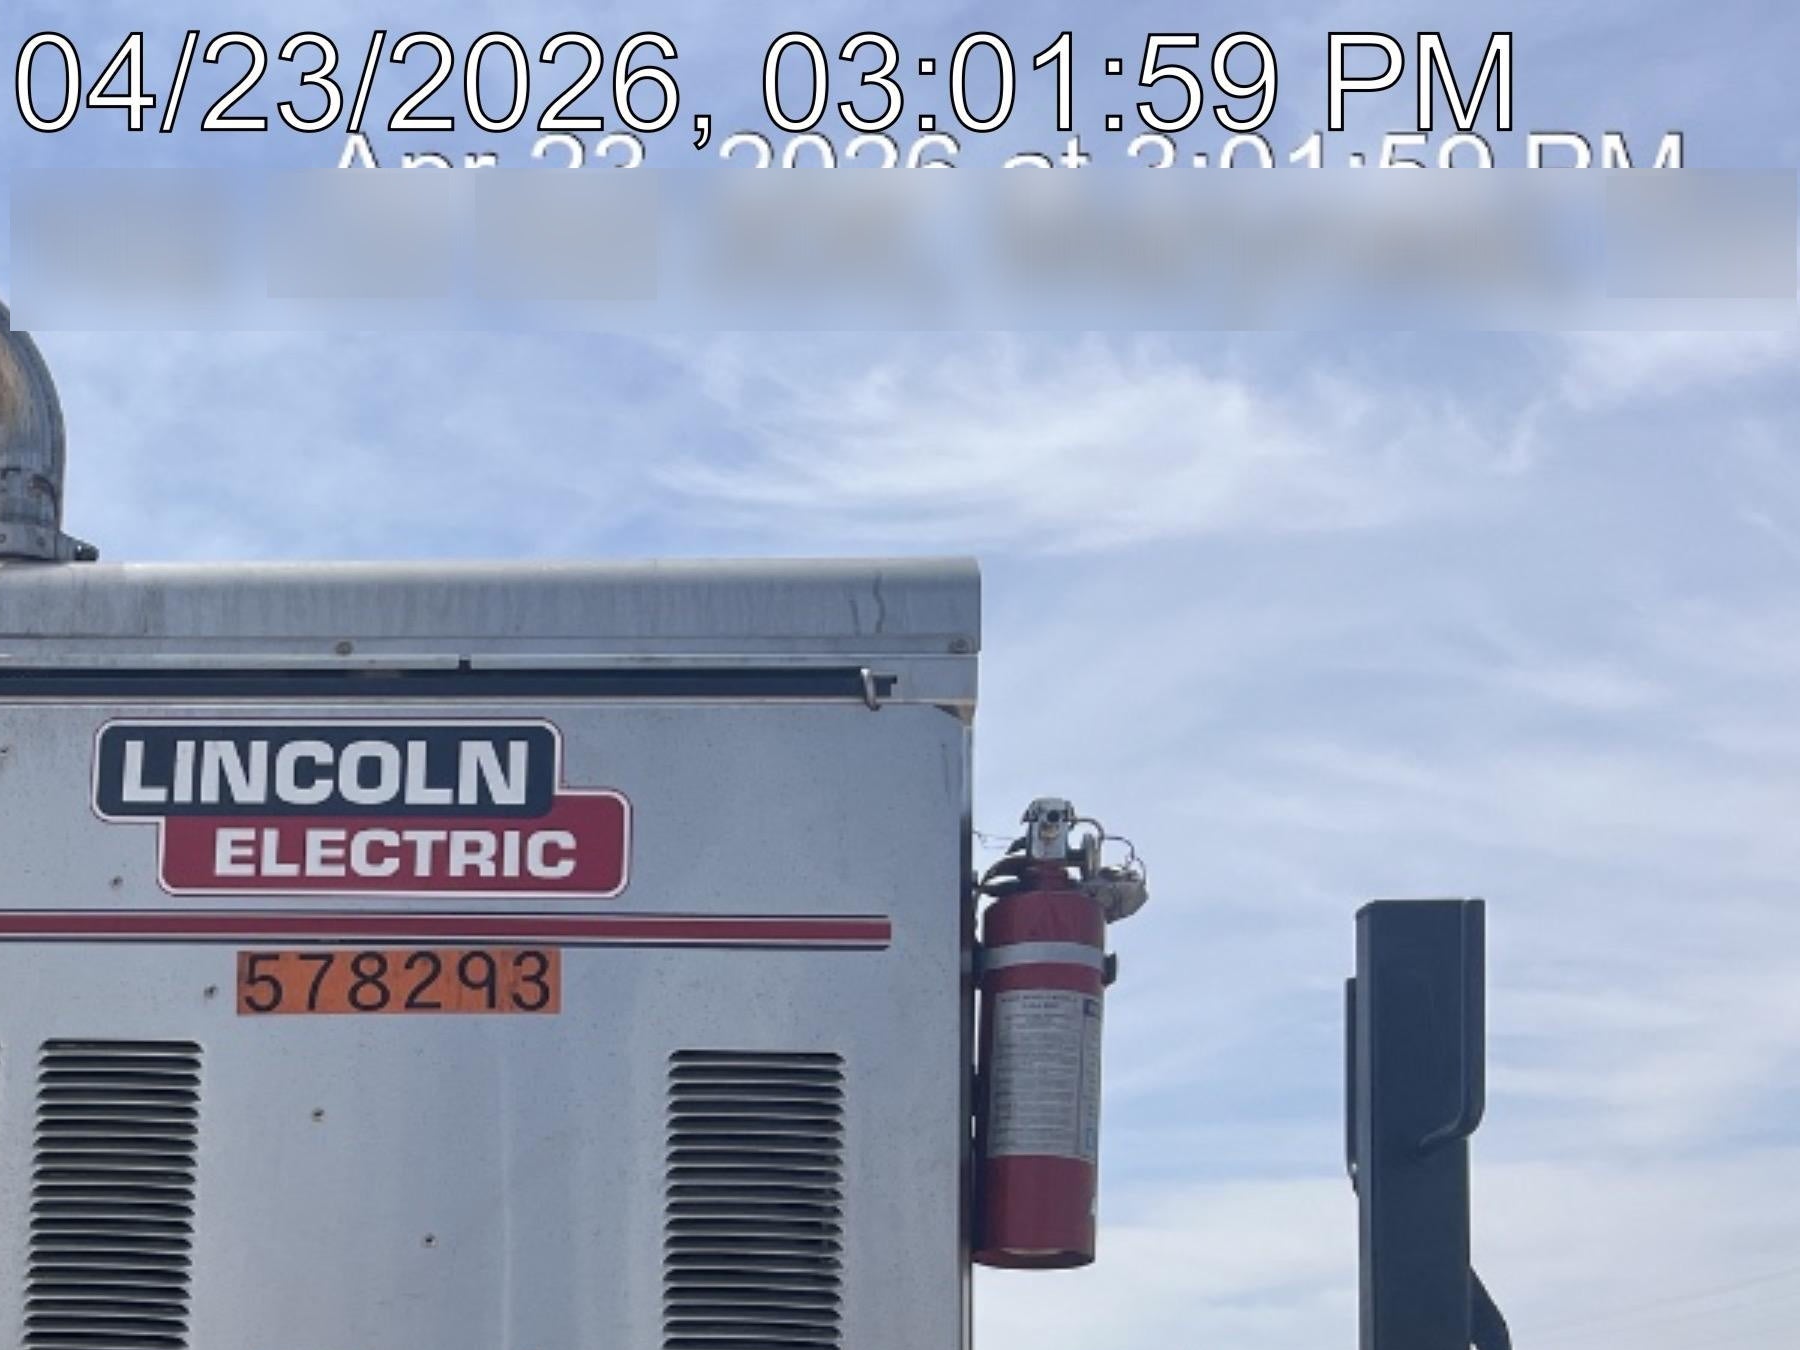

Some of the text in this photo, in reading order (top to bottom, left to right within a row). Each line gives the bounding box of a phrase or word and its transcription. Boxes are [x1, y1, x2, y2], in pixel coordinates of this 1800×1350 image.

[121, 740, 529, 805] LINCOLN
[214, 828, 577, 880] ELECTRIC
[243, 950, 552, 1013] 578293
